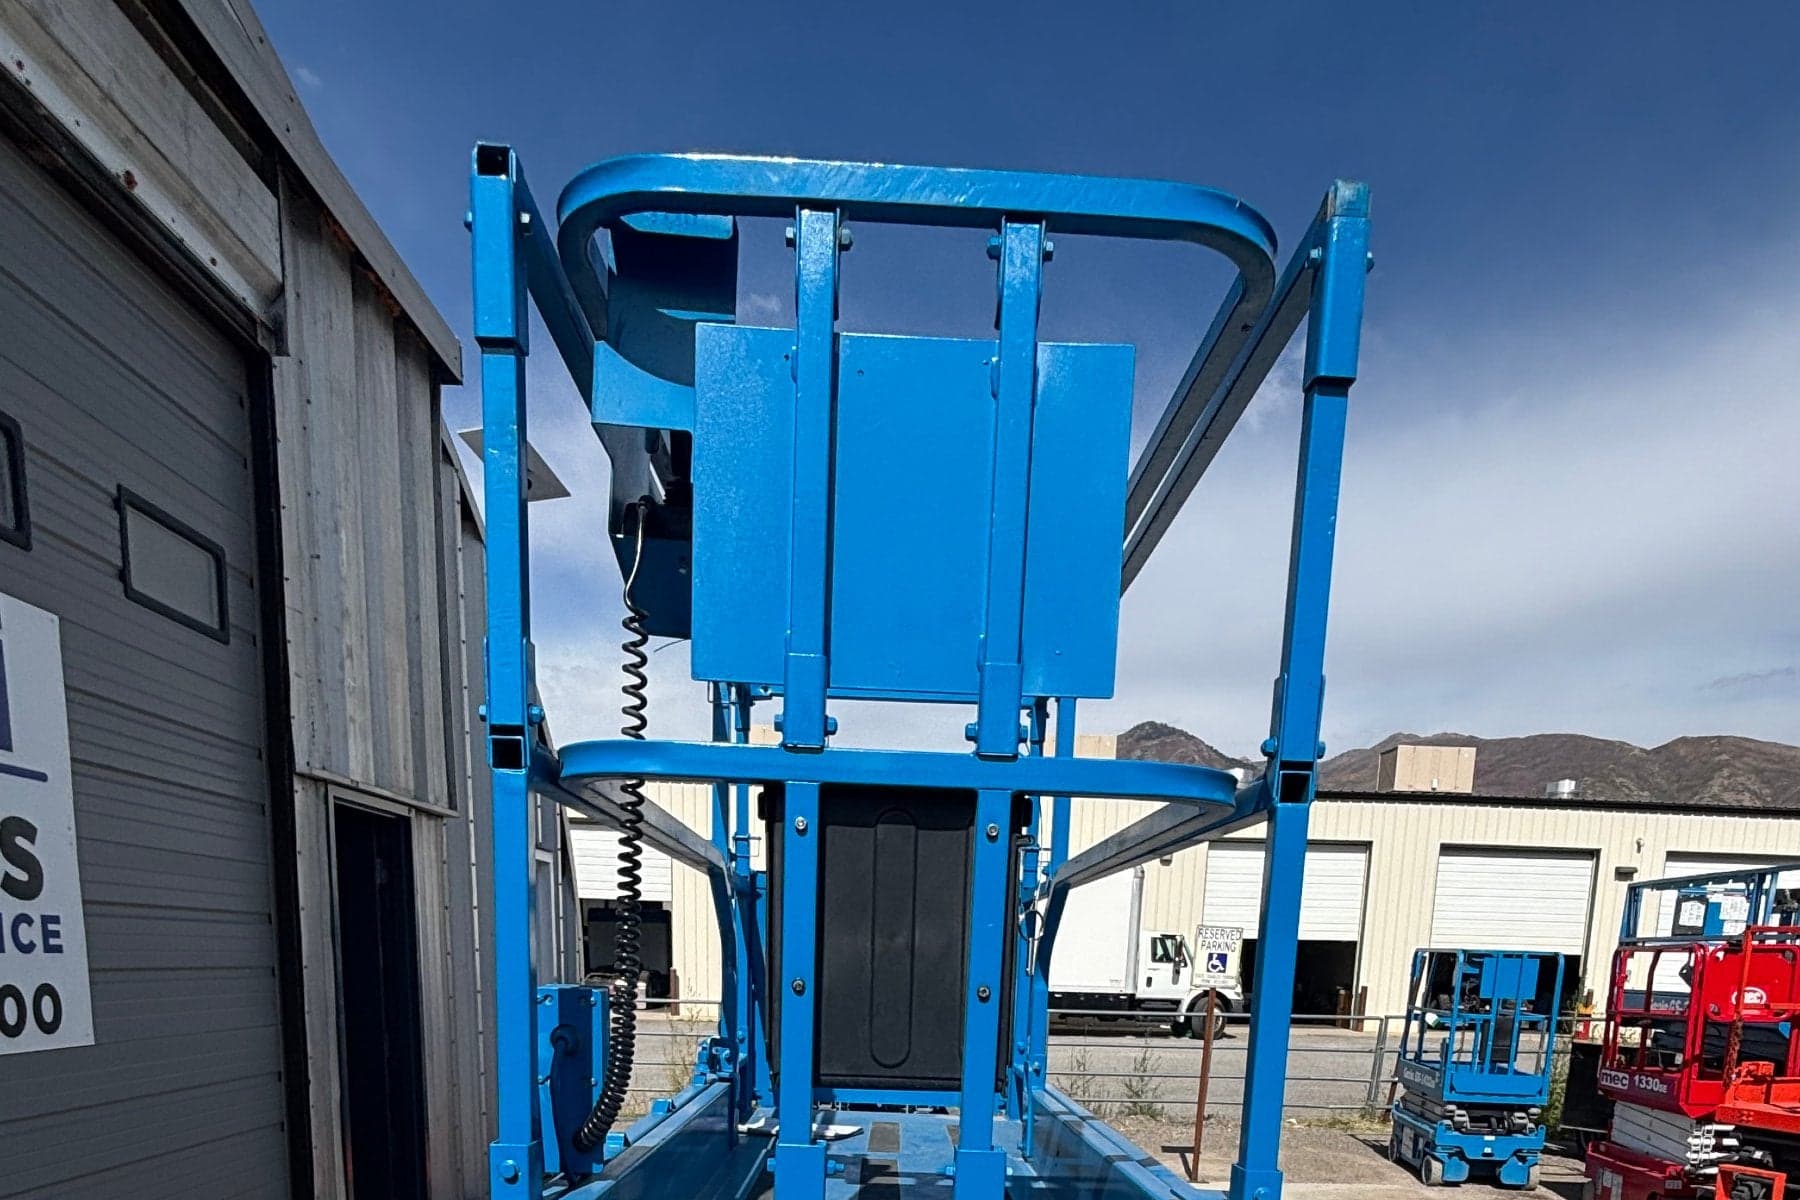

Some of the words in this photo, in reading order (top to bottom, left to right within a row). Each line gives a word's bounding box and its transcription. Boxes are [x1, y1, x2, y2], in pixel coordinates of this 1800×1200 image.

[0, 816, 44, 901] S
[1198, 928, 1242, 940] RESERVED
[1200, 939, 1237, 952] PARKING
[1601, 1070, 1629, 1087] mec
